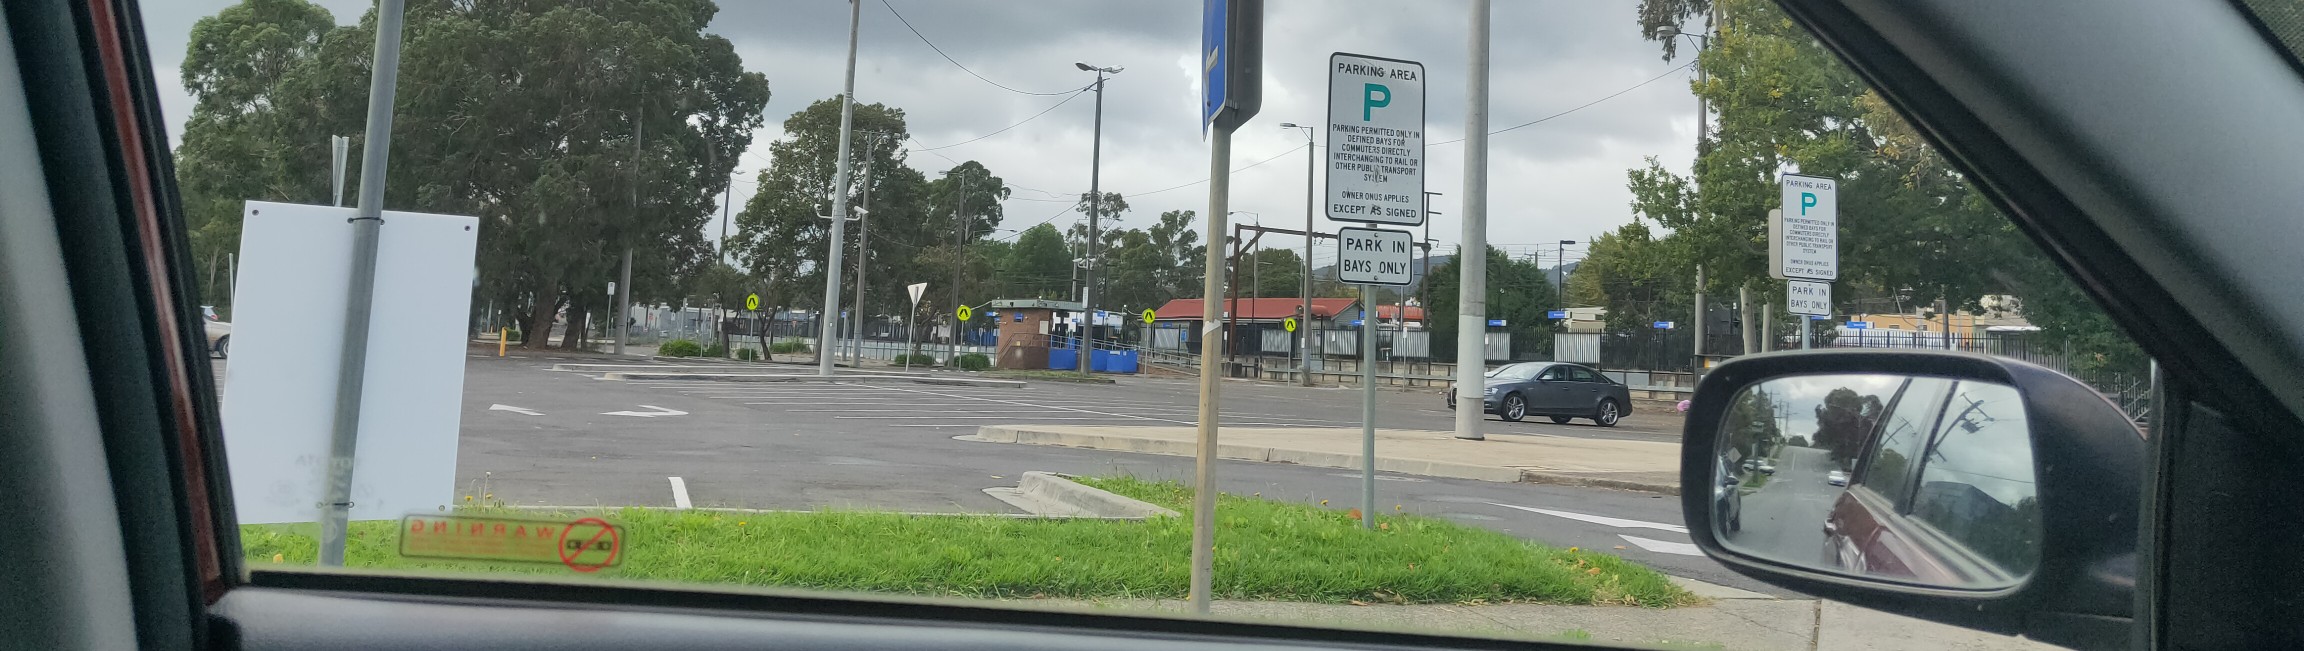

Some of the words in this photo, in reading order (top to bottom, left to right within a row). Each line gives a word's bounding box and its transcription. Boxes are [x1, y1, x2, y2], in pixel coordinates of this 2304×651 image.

[1338, 63, 1384, 78] PARKING
[1390, 69, 1417, 81] AREA
[1364, 82, 1391, 122] P
[1332, 124, 1360, 134] PARKING
[1362, 126, 1394, 136] PERMITTED
[1396, 130, 1412, 138] ONLY
[1348, 134, 1374, 144] DEFINED
[1376, 137, 1392, 146] BAYS
[1342, 144, 1380, 154] COMMUTERS
[1382, 147, 1410, 156] DIRECTLY
[1334, 152, 1384, 164] INTERCHANGING
[1394, 158, 1408, 166] RAIL
[1336, 162, 1356, 170] OTHER
[1357, 164, 1380, 172] PUBLIC
[1382, 166, 1416, 176] TRANSPORT
[1786, 180, 1812, 189] PARKING
[1342, 190, 1364, 200] OWNER
[1365, 192, 1382, 201] ONUS
[1384, 194, 1409, 203] APPLIES
[1334, 204, 1366, 214] EXCEPT
[1370, 206, 1382, 215] AS
[1386, 208, 1416, 218] SIGNED
[1802, 192, 1817, 216] P
[1346, 238, 1382, 252] PARK
[1392, 240, 1404, 253] IN
[1344, 260, 1372, 272] BAYS
[1380, 262, 1406, 274] ONLY
[1792, 286, 1814, 295] PARK
[1790, 300, 1808, 308] BAYS
[1812, 300, 1827, 310] ONLY
